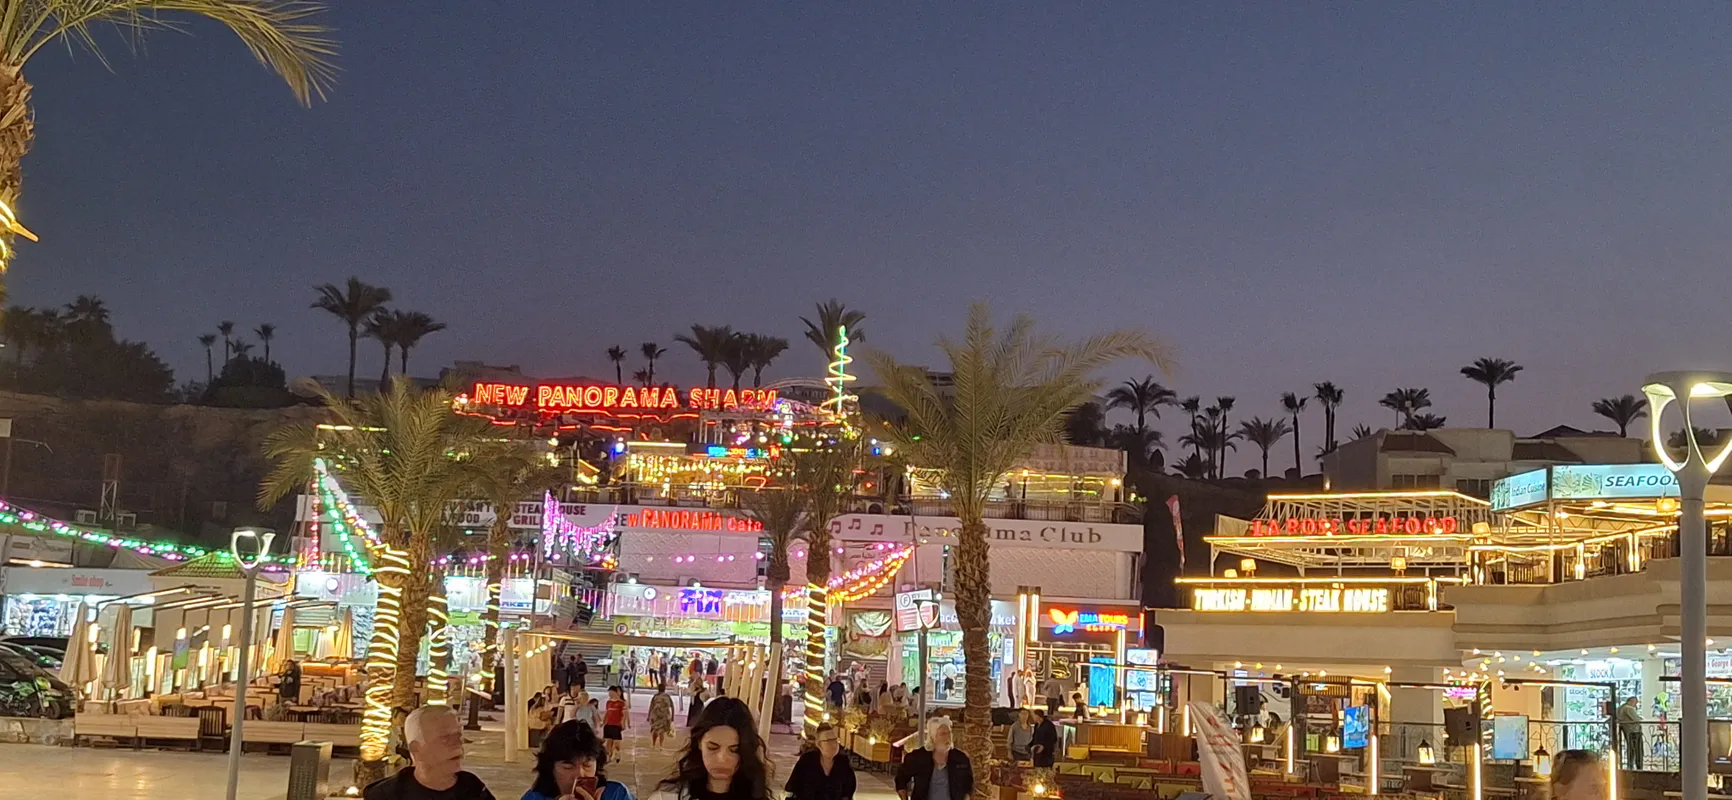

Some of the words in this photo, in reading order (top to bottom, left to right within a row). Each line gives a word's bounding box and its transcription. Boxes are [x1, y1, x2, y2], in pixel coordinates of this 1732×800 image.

[475, 383, 529, 405] NEW
[537, 385, 679, 408] PANORAMA
[689, 387, 778, 410] SHARM
[641, 508, 722, 531] PANORAMA
[1252, 519, 1281, 537] LA
[1285, 518, 1340, 536] ROSE
[1347, 516, 1457, 534] SEAFOOD
[1040, 526, 1102, 543] Club
[1299, 588, 1341, 612] STEAK
